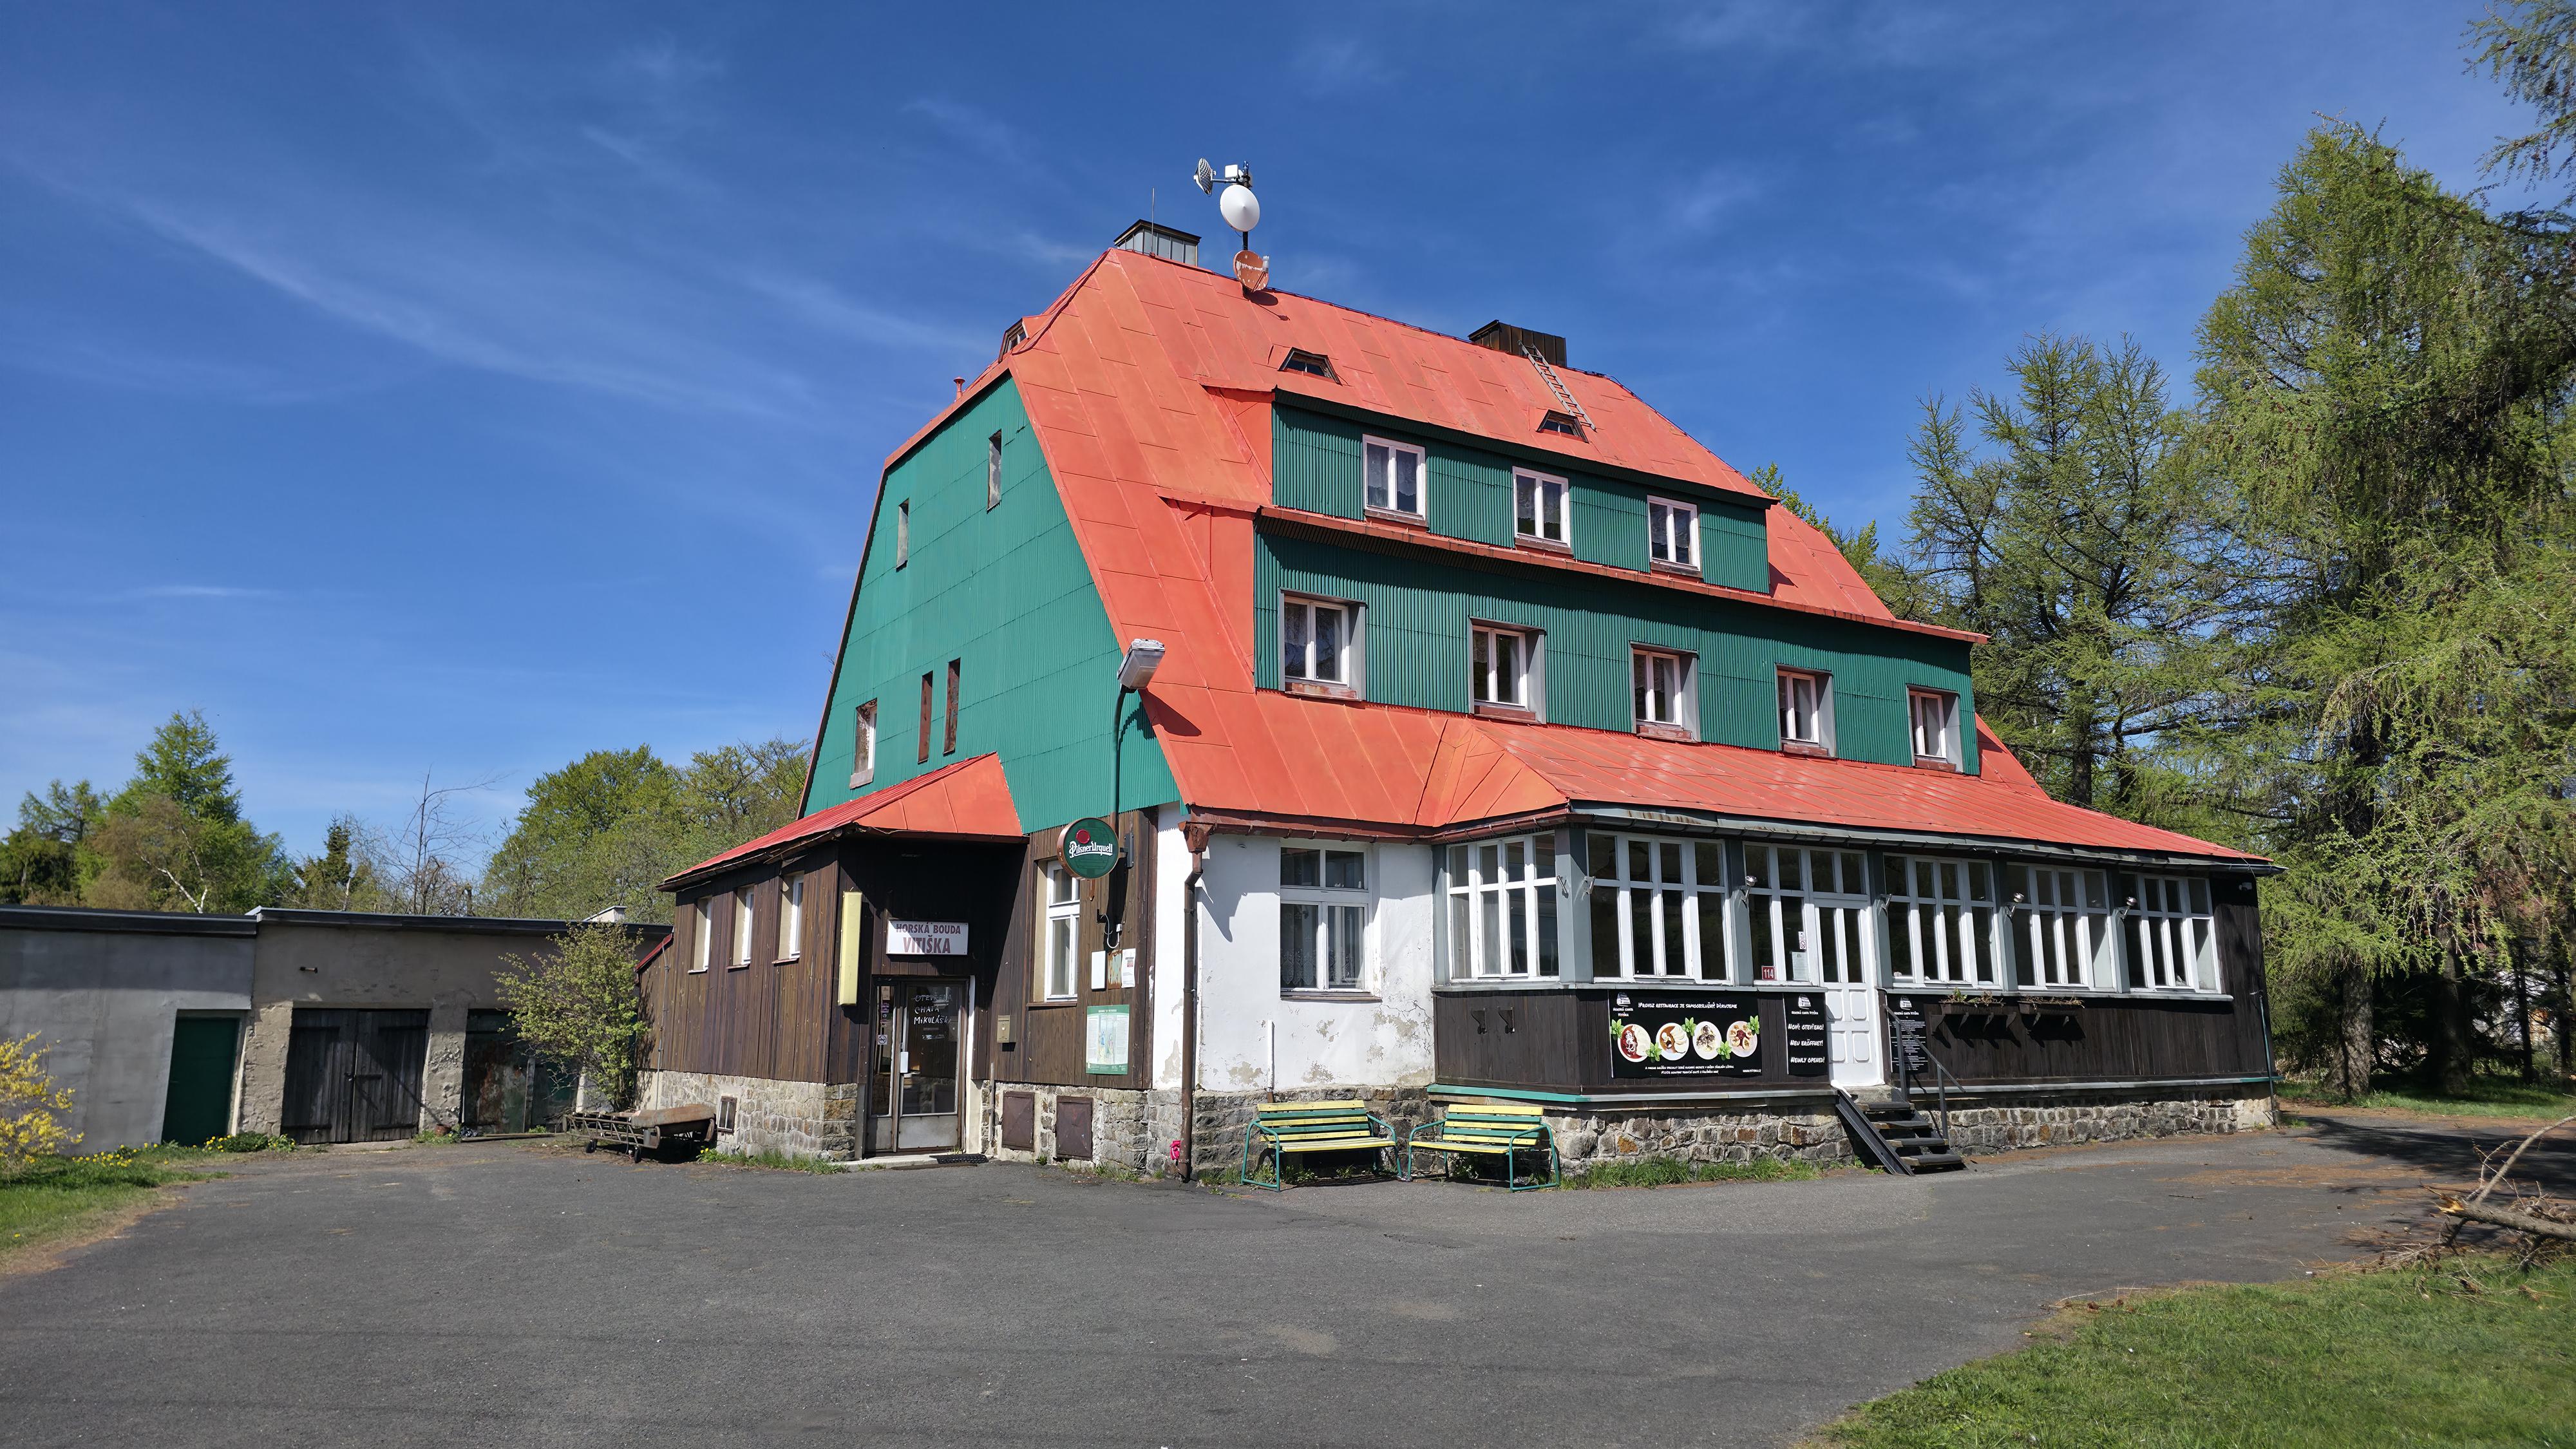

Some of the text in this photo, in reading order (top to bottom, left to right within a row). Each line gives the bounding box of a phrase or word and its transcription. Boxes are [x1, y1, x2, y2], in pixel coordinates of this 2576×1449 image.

[1069, 840, 1113, 858] Pilsner Urquell
[896, 922, 961, 934] HORSKÁ BOUDA
[903, 934, 951, 953] VITIŠKA
[1764, 969, 1774, 978] 114
